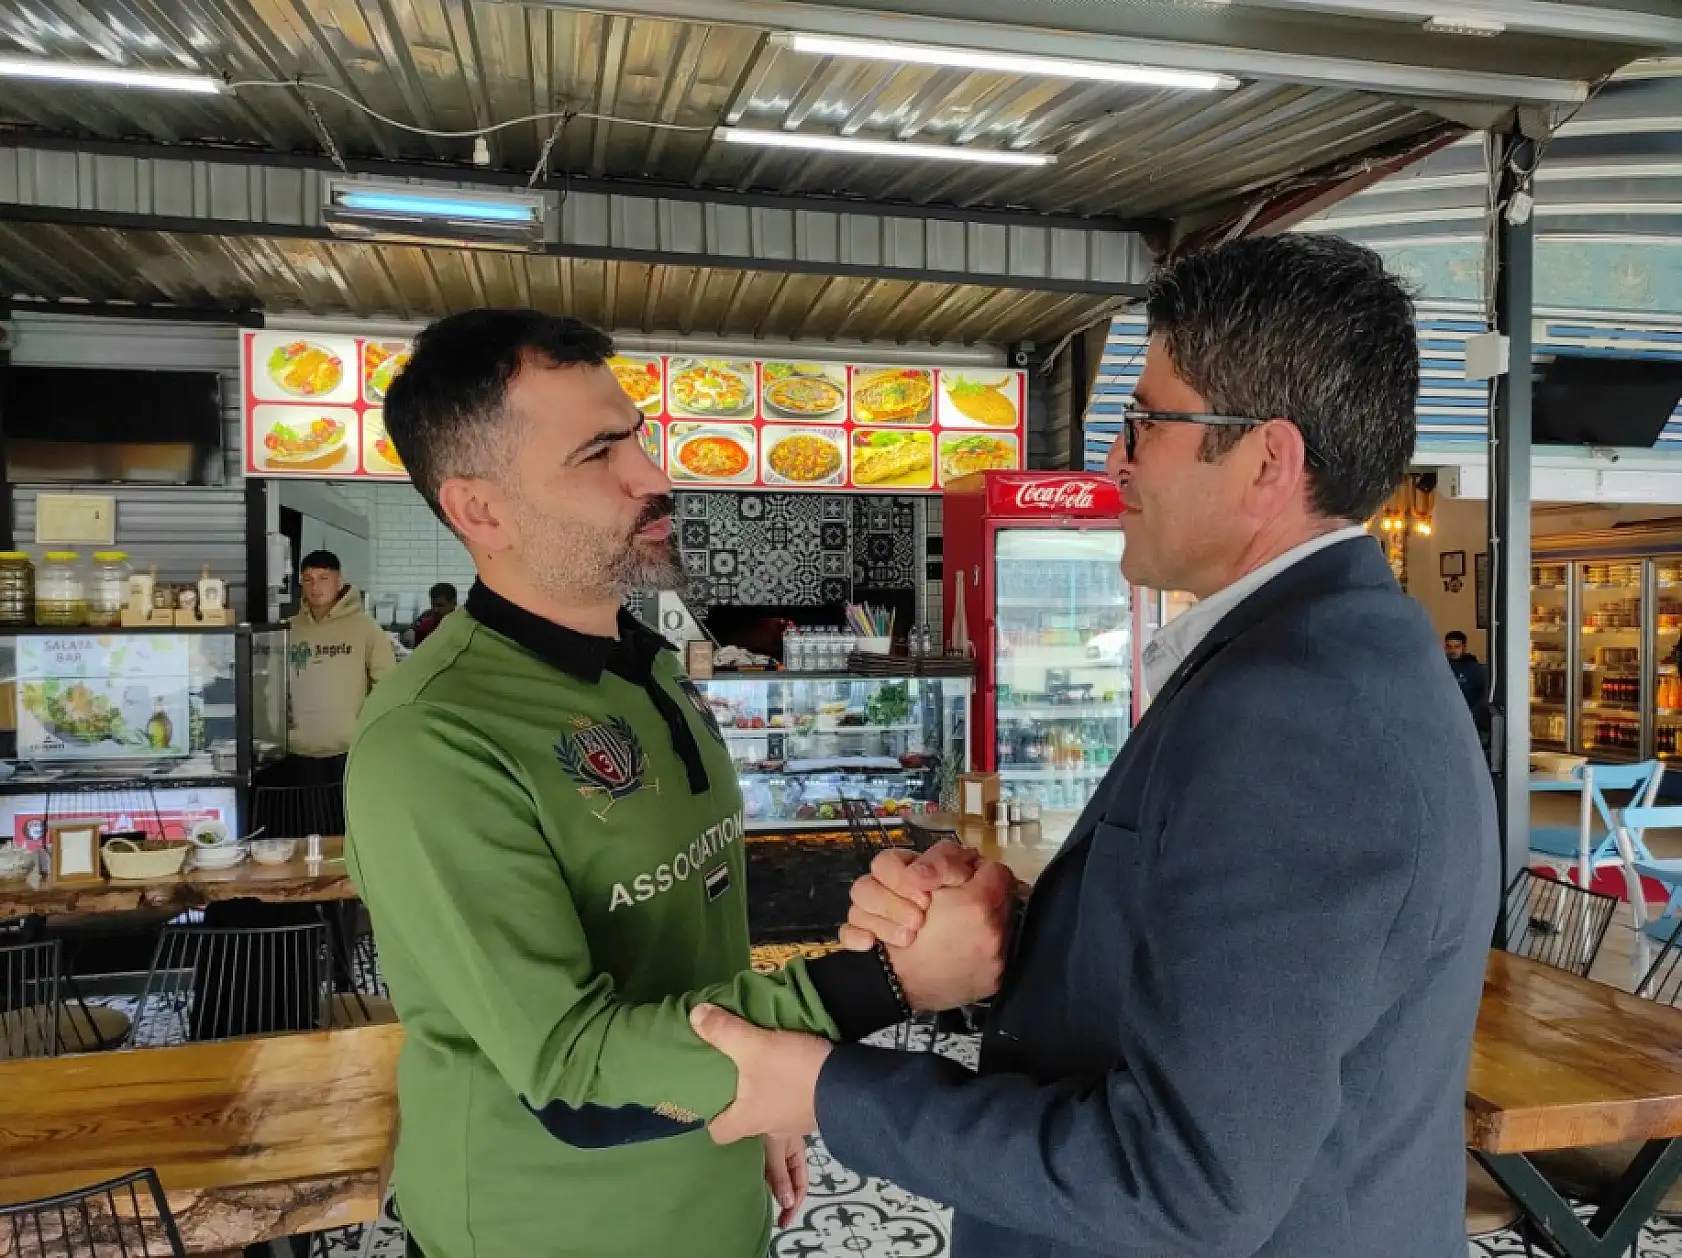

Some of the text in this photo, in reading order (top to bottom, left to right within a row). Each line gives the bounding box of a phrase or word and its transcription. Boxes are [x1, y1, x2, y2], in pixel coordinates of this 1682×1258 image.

[44, 639, 91, 650] SALATA
[56, 652, 82, 663] BAR
[608, 809, 745, 912] ASSOCIATION
